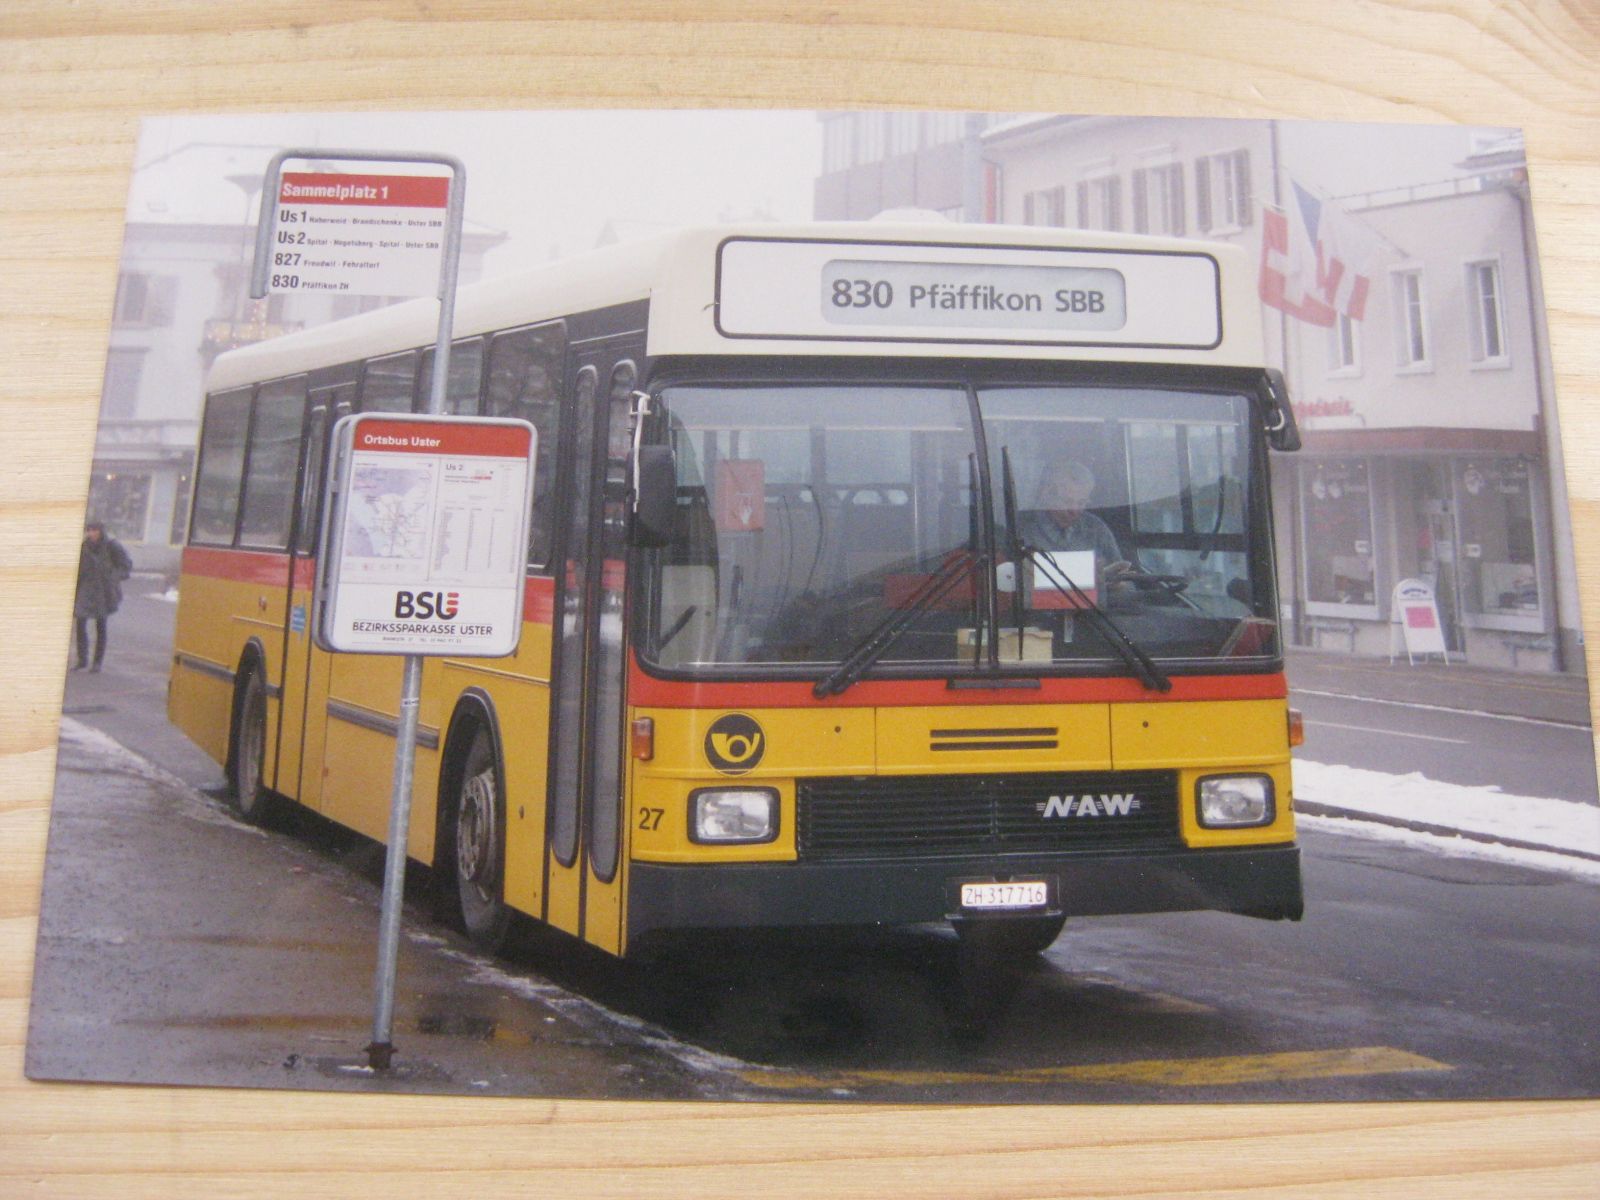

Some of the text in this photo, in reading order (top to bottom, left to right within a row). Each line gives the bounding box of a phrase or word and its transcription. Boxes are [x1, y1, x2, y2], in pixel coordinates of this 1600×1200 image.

[282, 183, 389, 200] Sammelplatz 1
[280, 210, 298, 223] Us
[300, 211, 308, 223] 1
[278, 231, 295, 244] Us
[297, 232, 306, 245] 2
[307, 238, 328, 246] Spital
[274, 253, 302, 267] 827
[271, 274, 300, 289] 830
[831, 278, 1106, 314] 830 Pfäffikon SBB
[364, 434, 441, 448] Ortsbus Uster
[352, 621, 493, 636] BEZIRKSSPARKASSE USTER
[1042, 793, 1135, 818] NAW
[639, 806, 665, 831] 27
